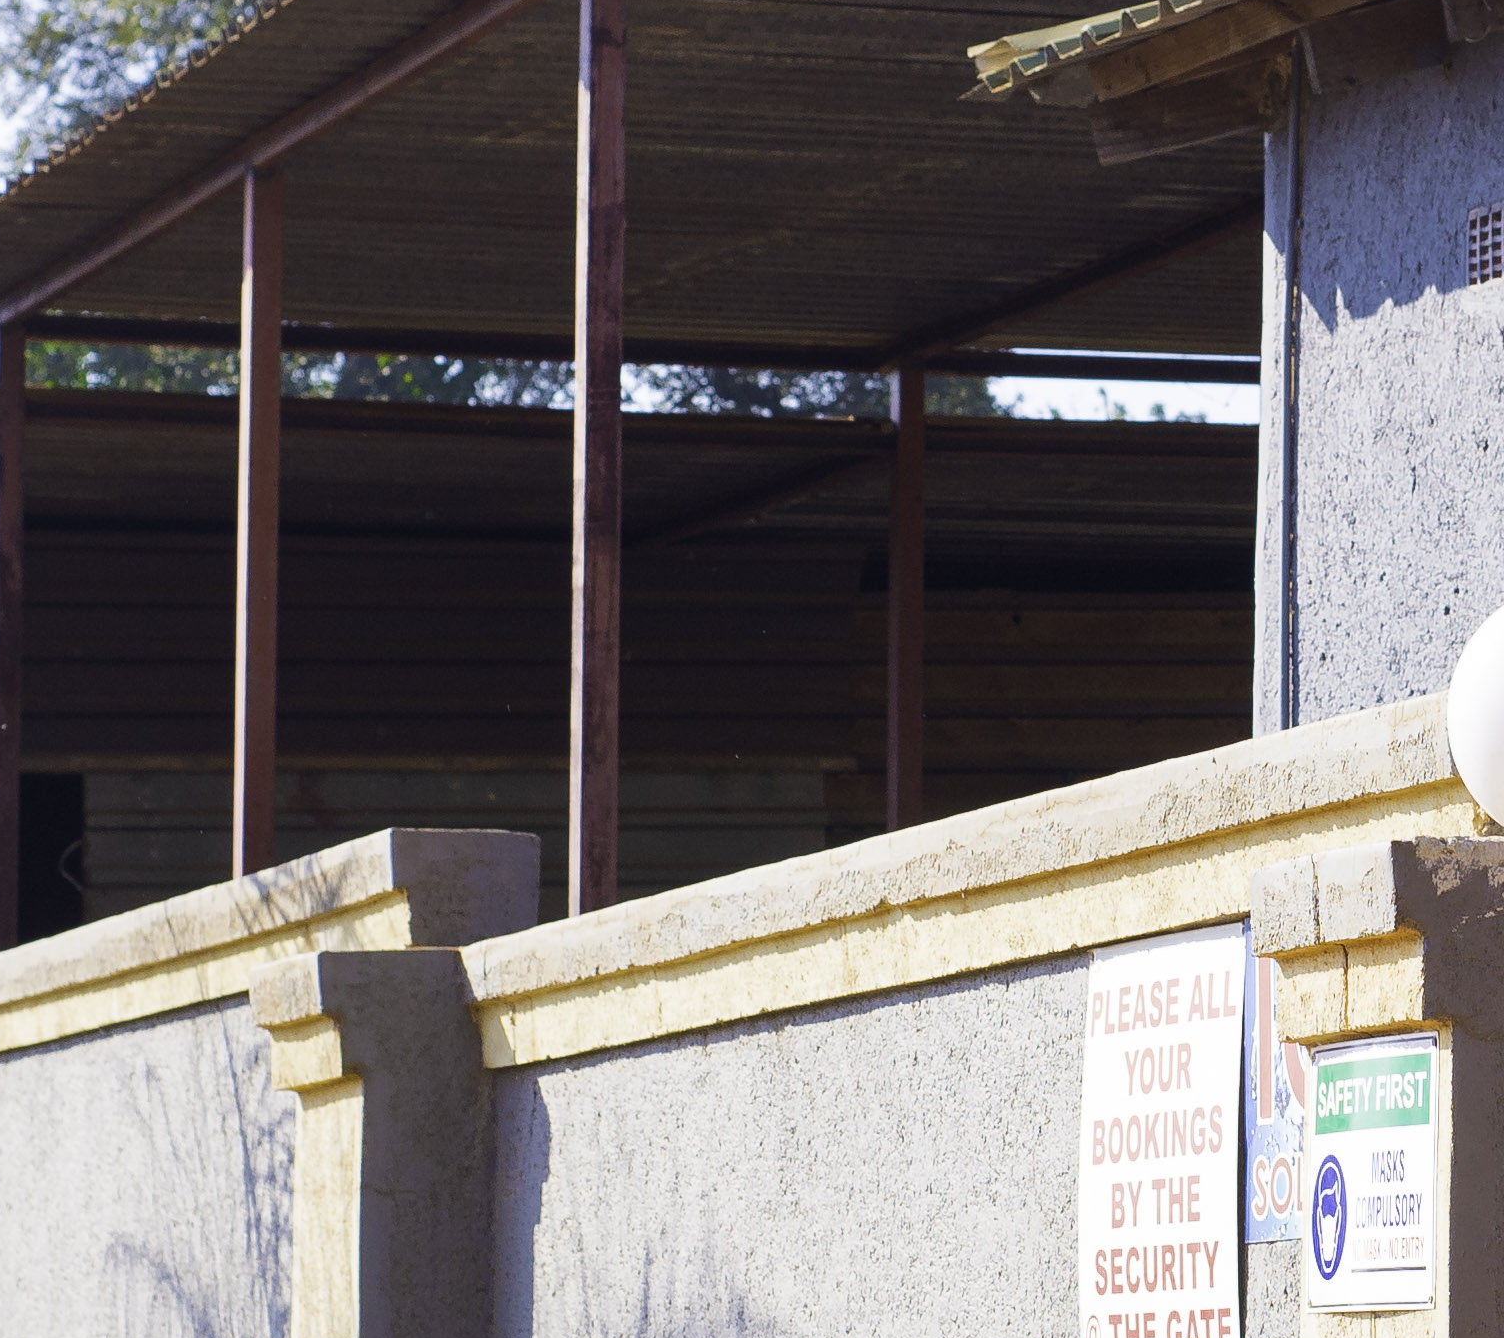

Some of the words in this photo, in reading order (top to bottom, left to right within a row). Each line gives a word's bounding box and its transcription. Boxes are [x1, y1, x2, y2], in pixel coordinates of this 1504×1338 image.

[1090, 977, 1180, 1038] PLEASE
[1188, 970, 1237, 1022] ALL
[1124, 1042, 1192, 1097] YOUR
[1317, 1075, 1375, 1118] SAFETY
[1375, 1070, 1428, 1112] FIRST
[1092, 1105, 1223, 1166] BOOKINGS
[1371, 1149, 1406, 1184] MASKS
[1111, 1180, 1143, 1229] BY
[1151, 1175, 1201, 1226] THE
[1355, 1193, 1423, 1229] COMPULSORY
[1095, 1241, 1219, 1296] SECURITY
[1388, 1236, 1399, 1260] NO
[1401, 1235, 1425, 1259] ENTRY
